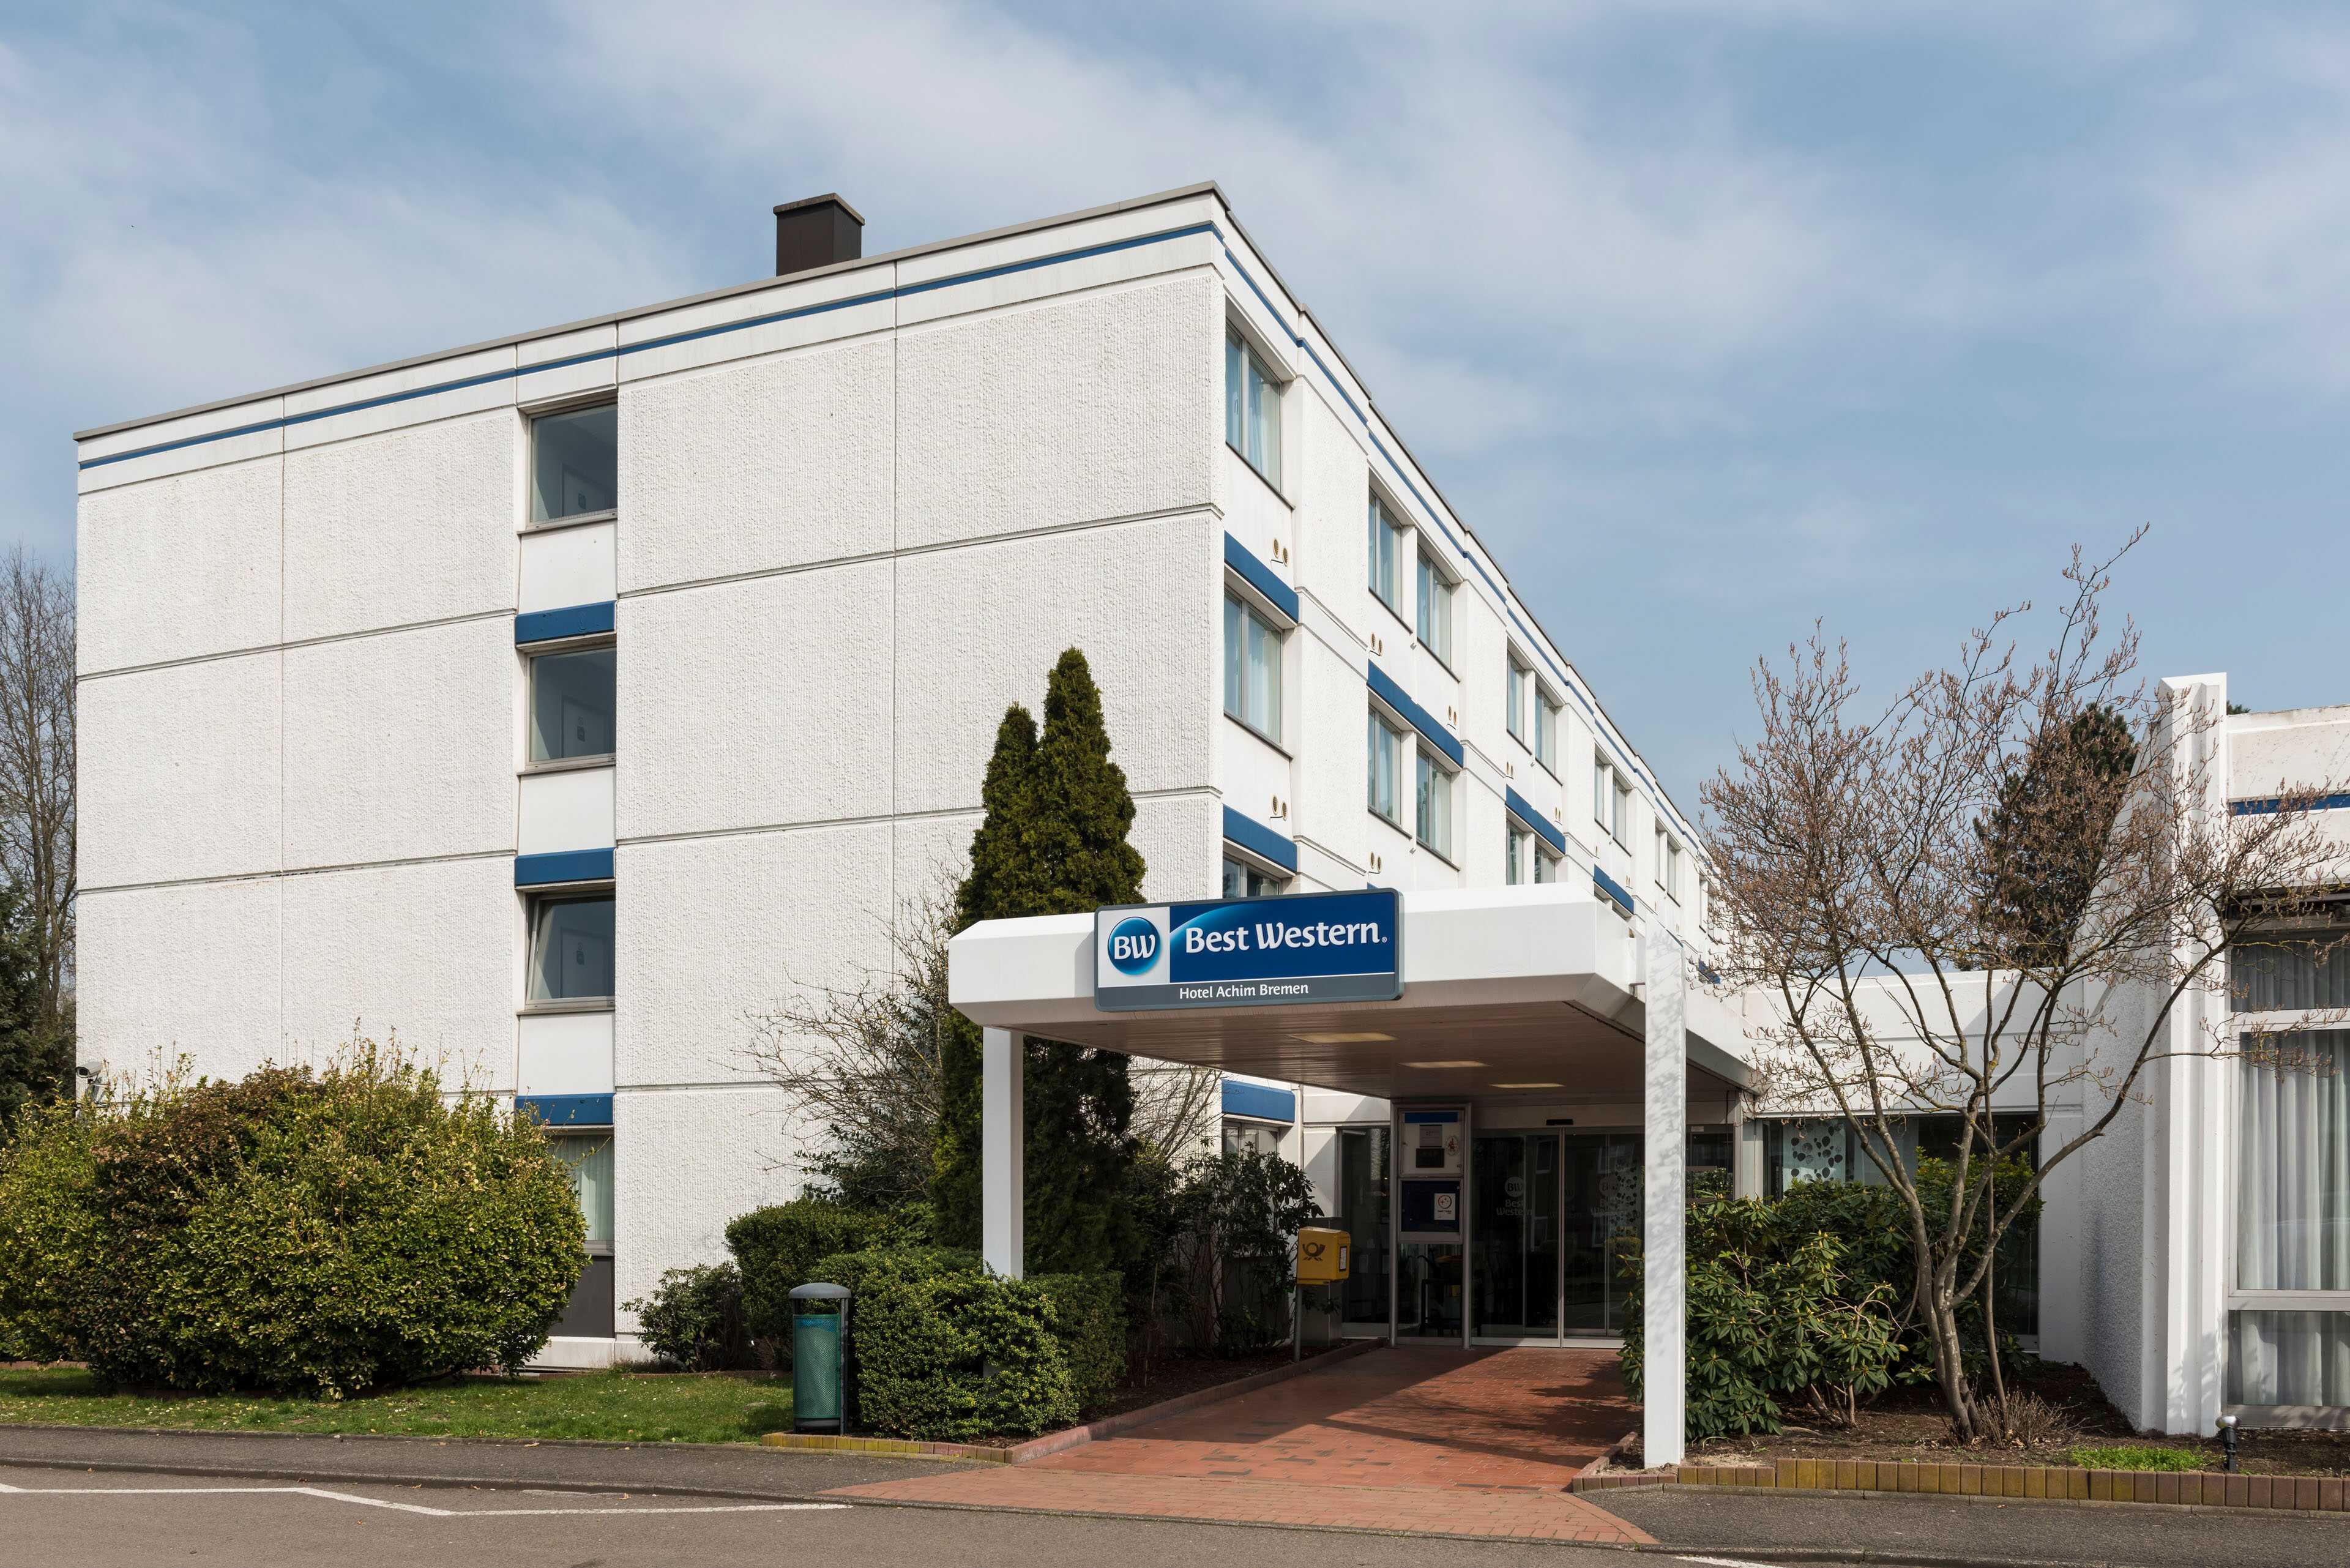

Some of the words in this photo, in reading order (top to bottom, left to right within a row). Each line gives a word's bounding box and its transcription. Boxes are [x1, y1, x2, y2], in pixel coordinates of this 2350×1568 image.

[1114, 934, 1156, 960] BW
[1186, 927, 1250, 953] Best
[1255, 922, 1380, 949] Western
[1179, 986, 1213, 999] Hotel
[1216, 984, 1256, 998] Achim
[1259, 984, 1308, 996] Bremen
